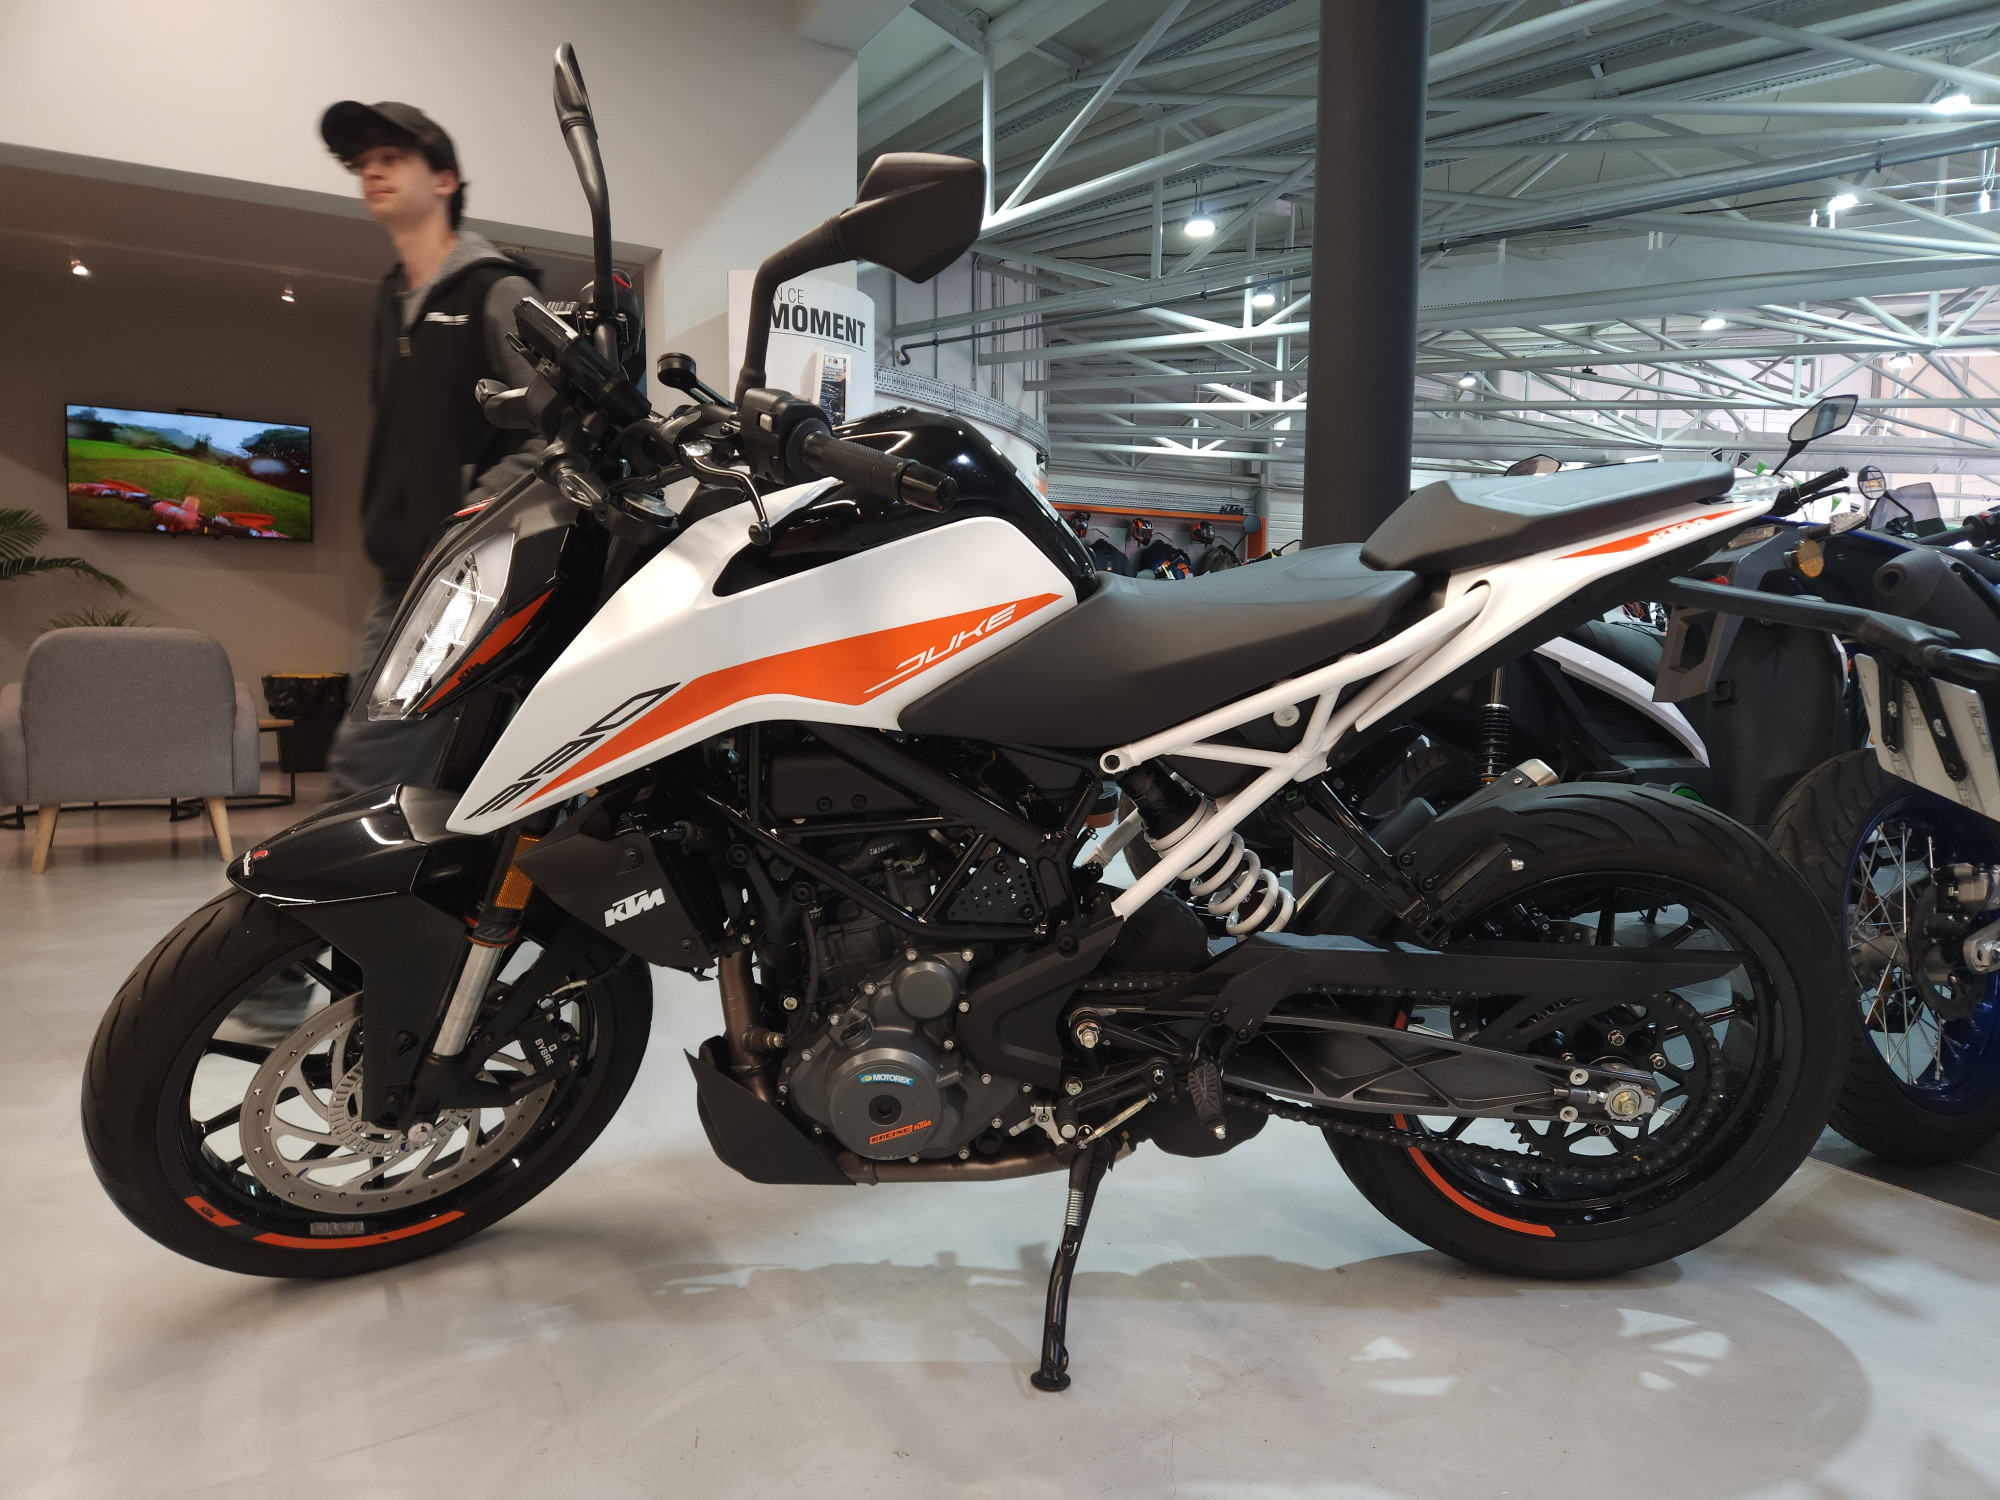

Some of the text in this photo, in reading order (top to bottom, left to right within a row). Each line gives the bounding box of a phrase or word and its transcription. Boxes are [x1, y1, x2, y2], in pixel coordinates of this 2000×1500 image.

[769, 303, 866, 347] MOMENT
[604, 887, 666, 928] KTM
[534, 1037, 554, 1067] BYBRE
[872, 1073, 911, 1085] MOTOREX
